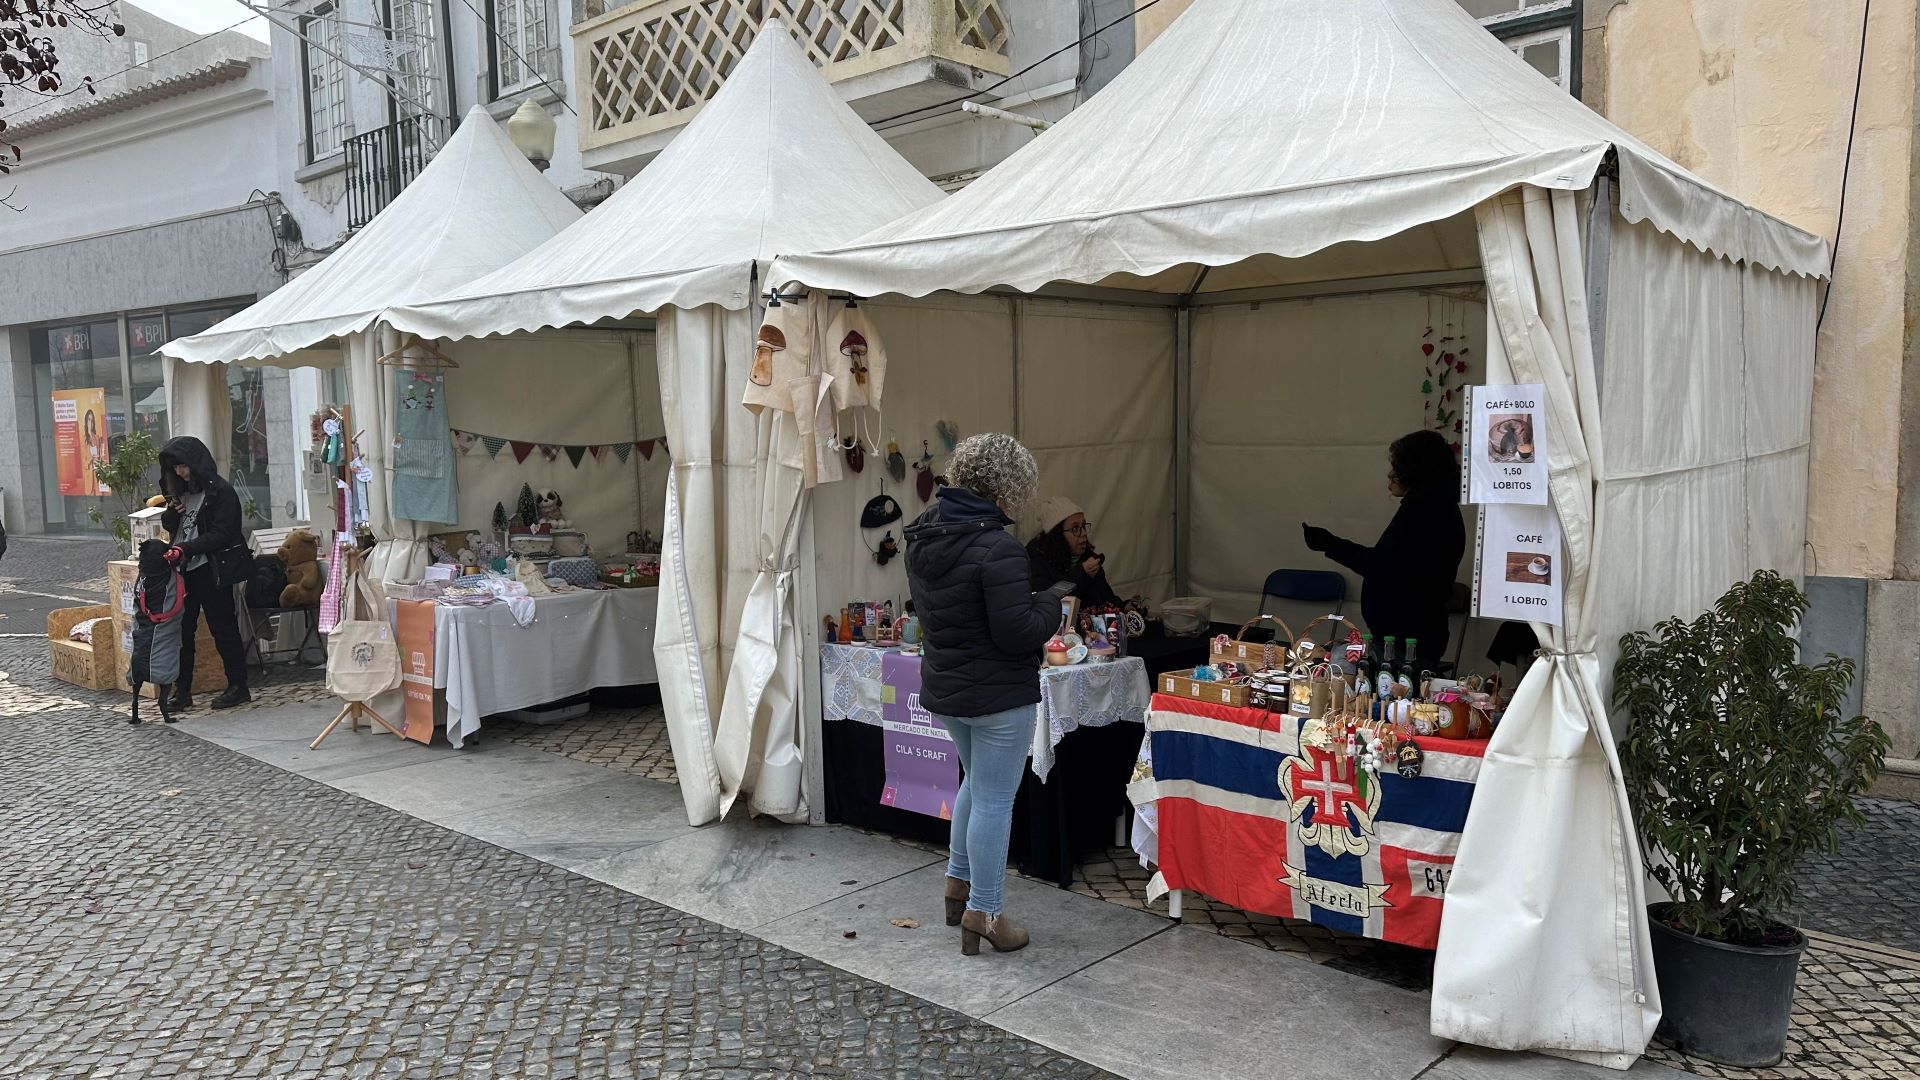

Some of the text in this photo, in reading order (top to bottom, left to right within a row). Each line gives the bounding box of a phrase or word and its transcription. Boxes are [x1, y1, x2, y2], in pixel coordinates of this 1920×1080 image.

[145, 323, 163, 343] BPI
[74, 331, 90, 351] BPI
[1503, 467, 1522, 476] 1,50
[1493, 481, 1532, 490] LOBITOS
[1516, 534, 1543, 544] CAFÉ
[1504, 595, 1548, 606] 1 LOBITO
[894, 723, 948, 739] MERCADO DE NATAL
[922, 749, 948, 762] CRAFT
